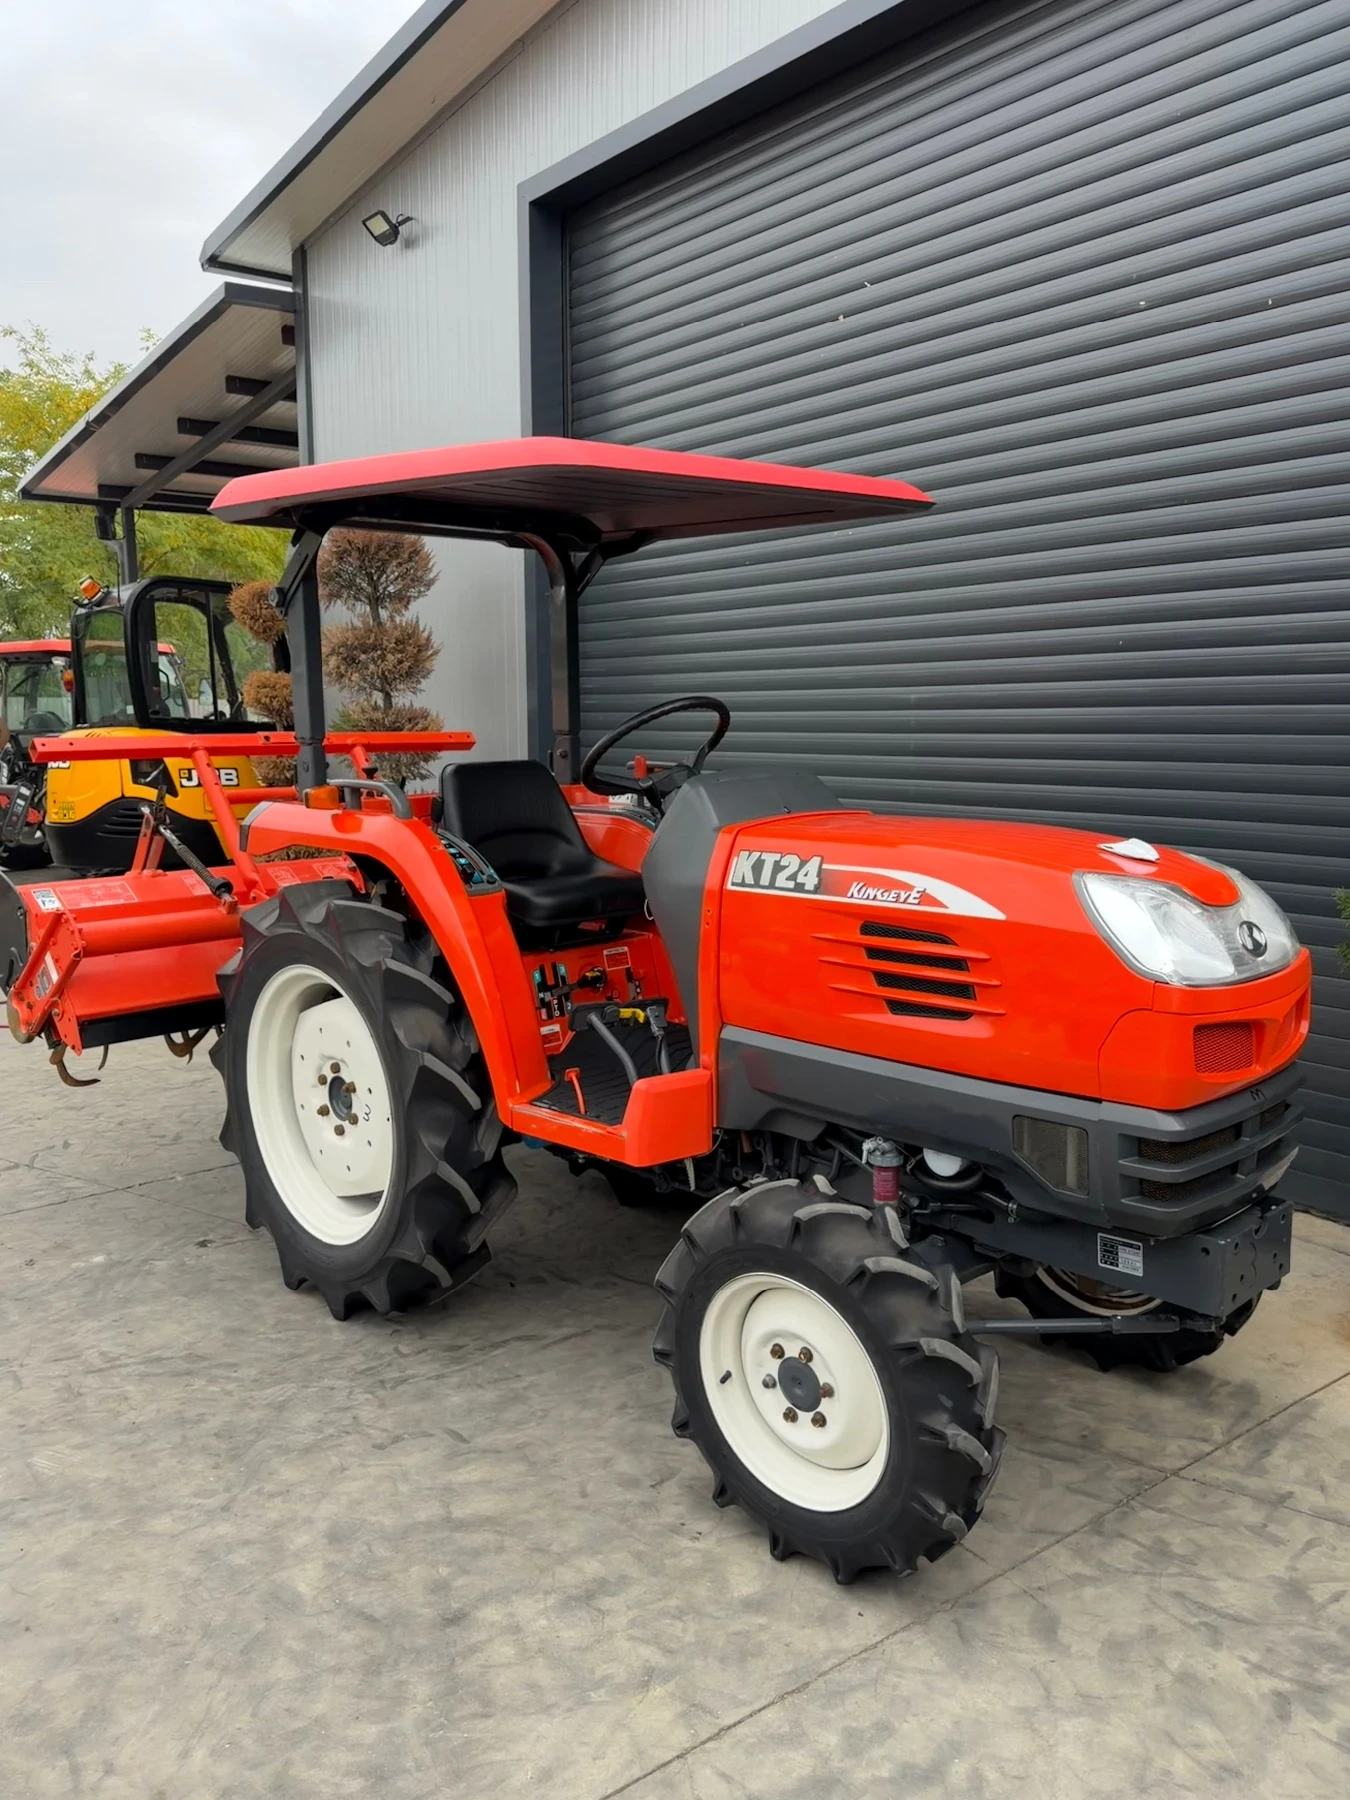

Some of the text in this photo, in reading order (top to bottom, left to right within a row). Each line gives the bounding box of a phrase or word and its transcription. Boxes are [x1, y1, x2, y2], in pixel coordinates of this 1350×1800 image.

[180, 769, 239, 787] JB
[732, 850, 822, 891] KT24
[846, 881, 927, 905] KINGEYE
[553, 999, 561, 1017] PTO
